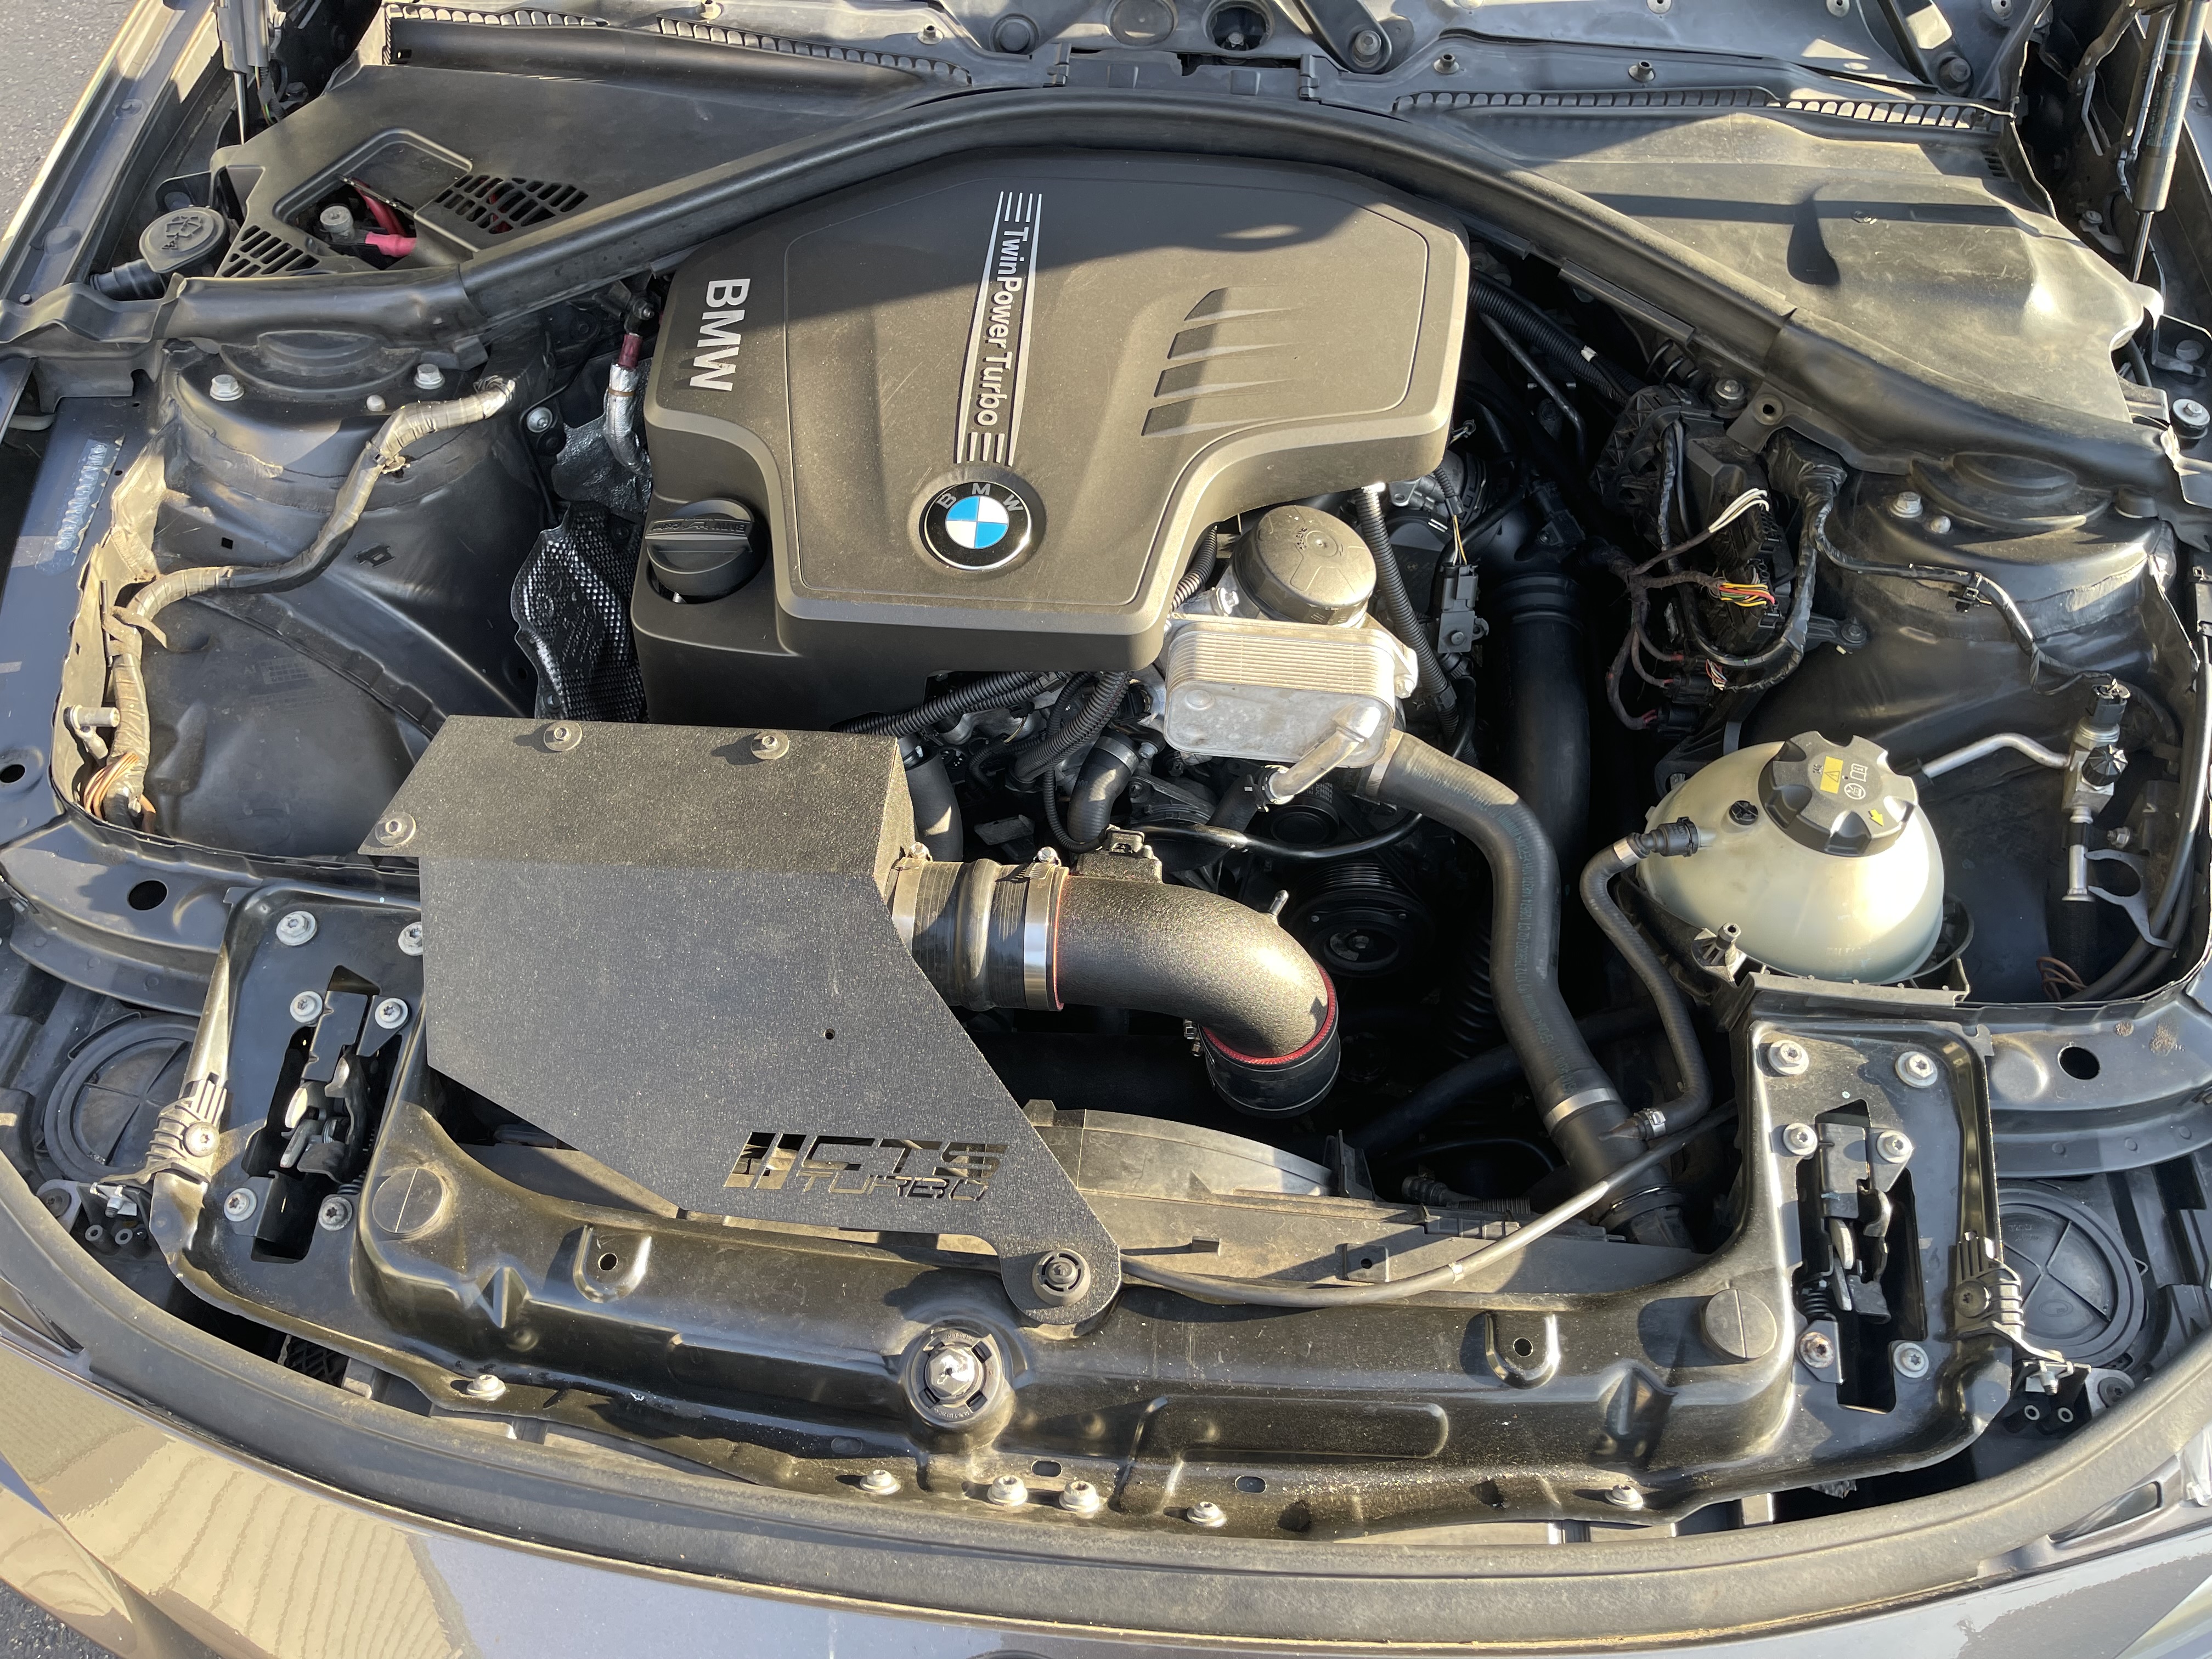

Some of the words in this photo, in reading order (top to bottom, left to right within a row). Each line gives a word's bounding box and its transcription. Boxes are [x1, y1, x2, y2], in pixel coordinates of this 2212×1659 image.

[985, 227, 1028, 349] TwinPower
[690, 278, 751, 392] BMW
[977, 351, 1014, 427] Turbo
[938, 482, 1024, 514] BMW
[1315, 787, 1333, 799] CHINA
[1517, 922, 1531, 931] CT
[1515, 968, 1528, 983] 1712
[800, 1135, 1008, 1180] CTS
[796, 1170, 991, 1201] TURBO
